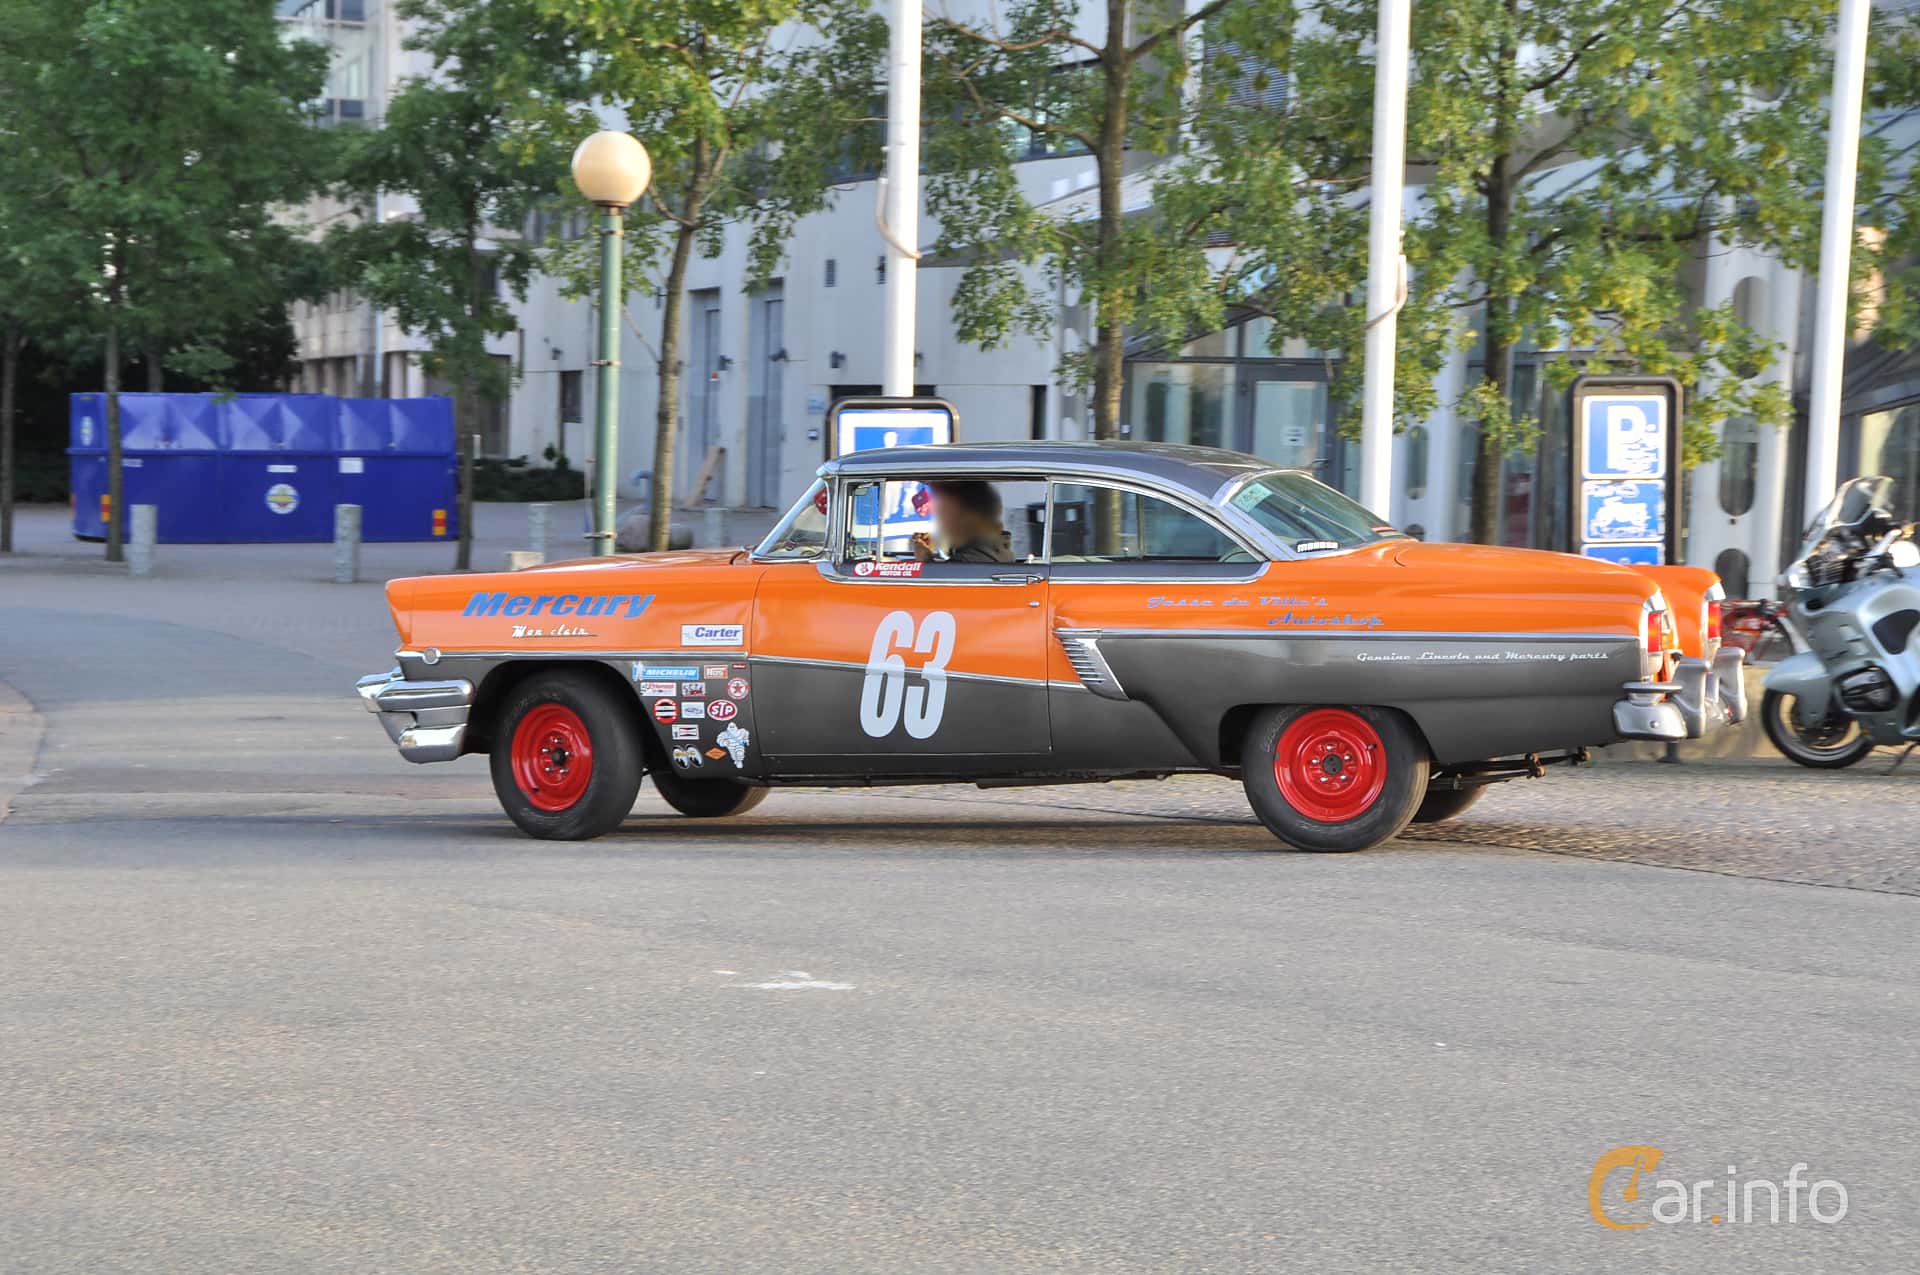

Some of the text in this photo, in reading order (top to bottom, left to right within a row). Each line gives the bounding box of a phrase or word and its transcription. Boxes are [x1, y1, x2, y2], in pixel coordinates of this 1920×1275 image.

[874, 562, 922, 571] Kendall
[462, 592, 656, 618] Mercury
[1267, 612, 1385, 629] Autoshop
[695, 627, 741, 638] Carter
[1356, 651, 1609, 662] Genuine Lincoln and Mercury parts
[645, 669, 697, 677] MICHELIN
[860, 610, 957, 739] 63
[711, 701, 734, 717] STP
